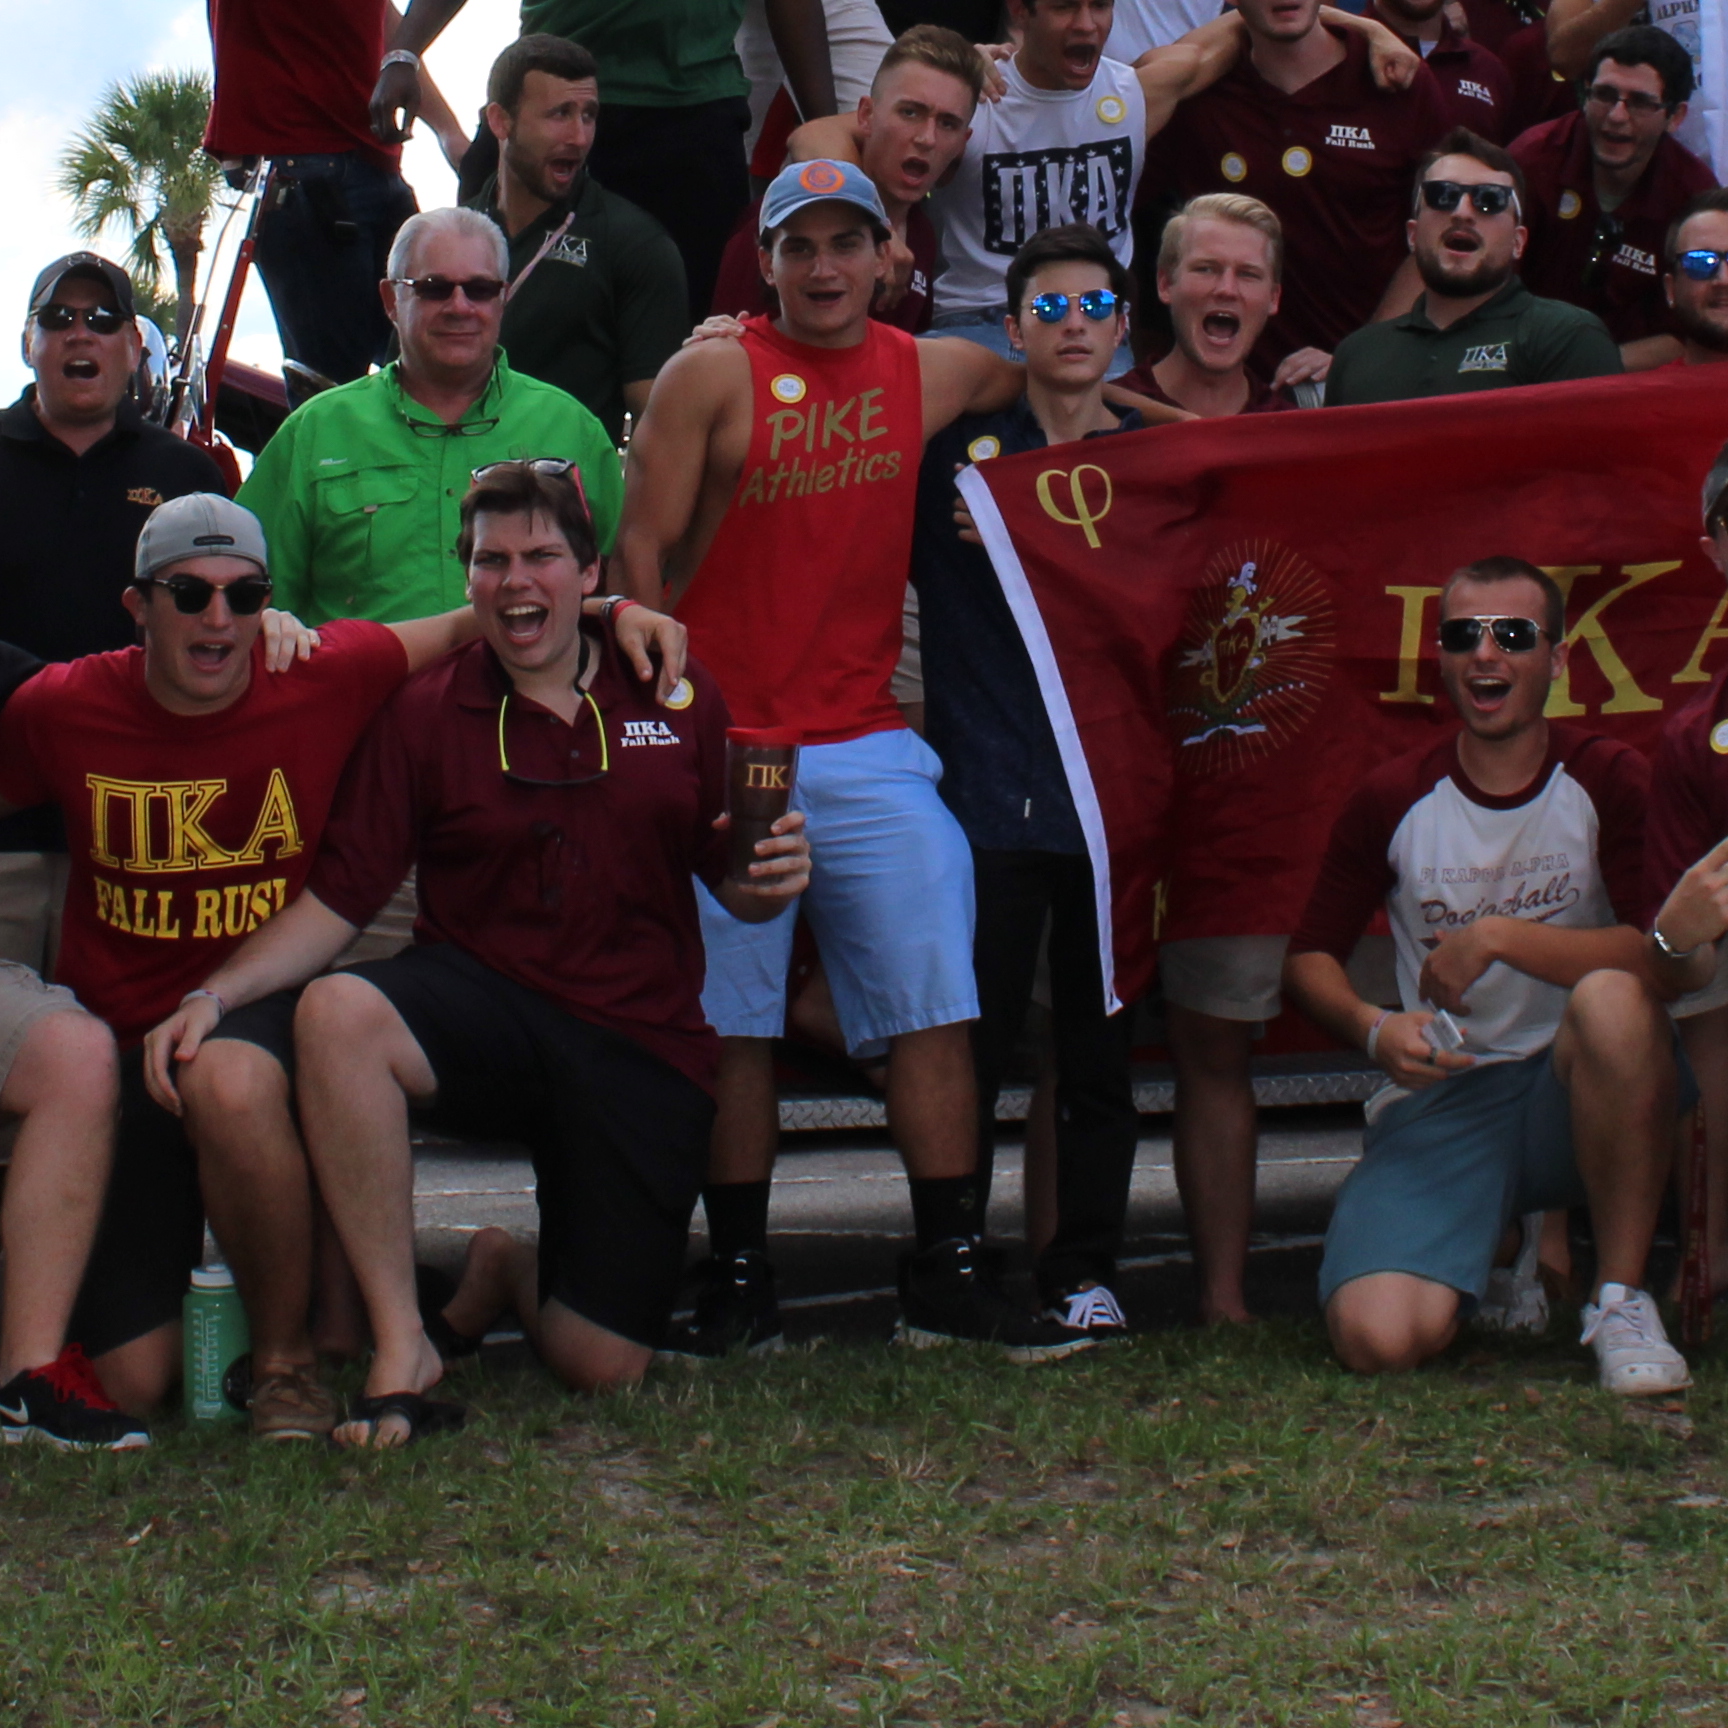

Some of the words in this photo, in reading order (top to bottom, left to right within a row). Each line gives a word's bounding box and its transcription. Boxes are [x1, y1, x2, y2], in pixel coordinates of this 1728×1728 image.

[1325, 137, 1346, 147] Fall
[1348, 139, 1375, 149] Rush
[766, 387, 888, 460] PIKE
[738, 447, 902, 508] Athletics
[621, 735, 647, 747] Fall
[648, 734, 680, 746] Rush
[93, 875, 180, 939] FALL
